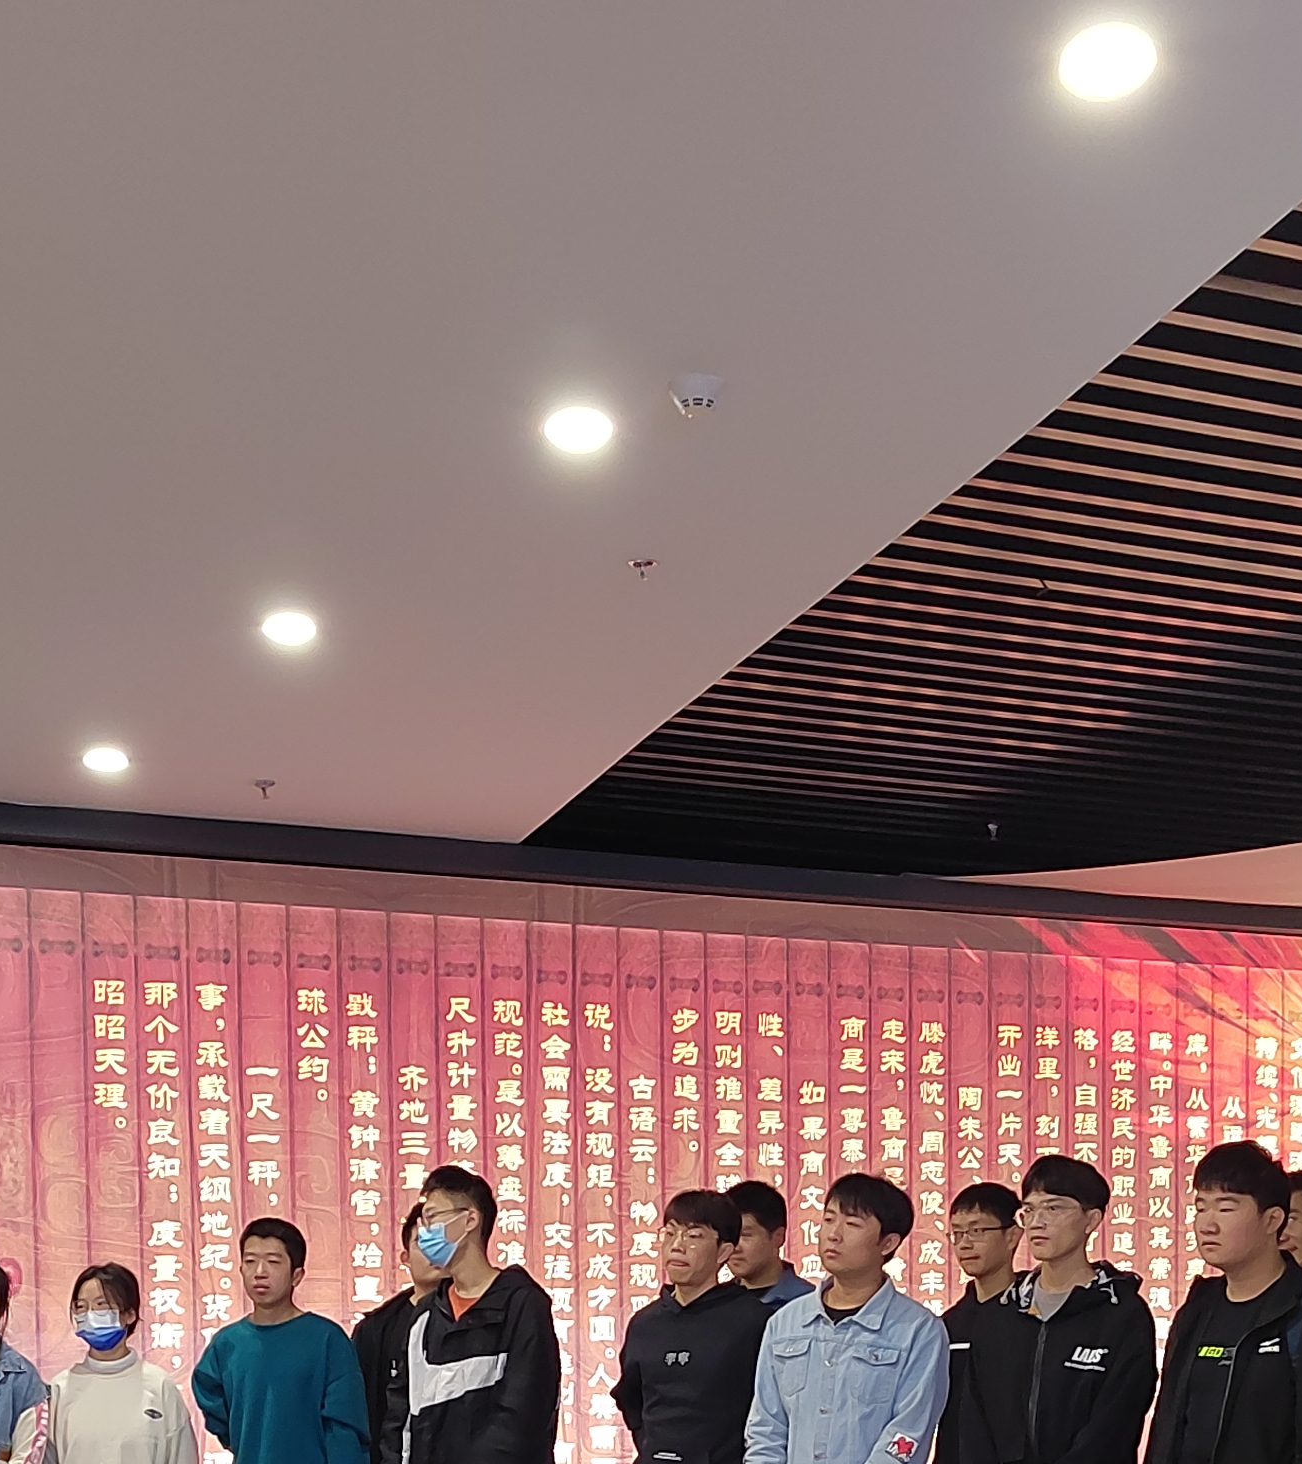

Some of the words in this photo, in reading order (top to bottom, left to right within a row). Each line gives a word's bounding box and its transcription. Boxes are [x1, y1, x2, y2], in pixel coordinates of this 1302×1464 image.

[93, 979, 128, 1130] 昭昭天理。
[296, 988, 331, 1102] 球公约。
[672, 1007, 701, 1154] 步为追求。
[756, 1012, 786, 1189] 性、差异性，
[996, 1024, 1024, 1184] 开出一片天。
[245, 1065, 282, 1207] 一尺一秤，
